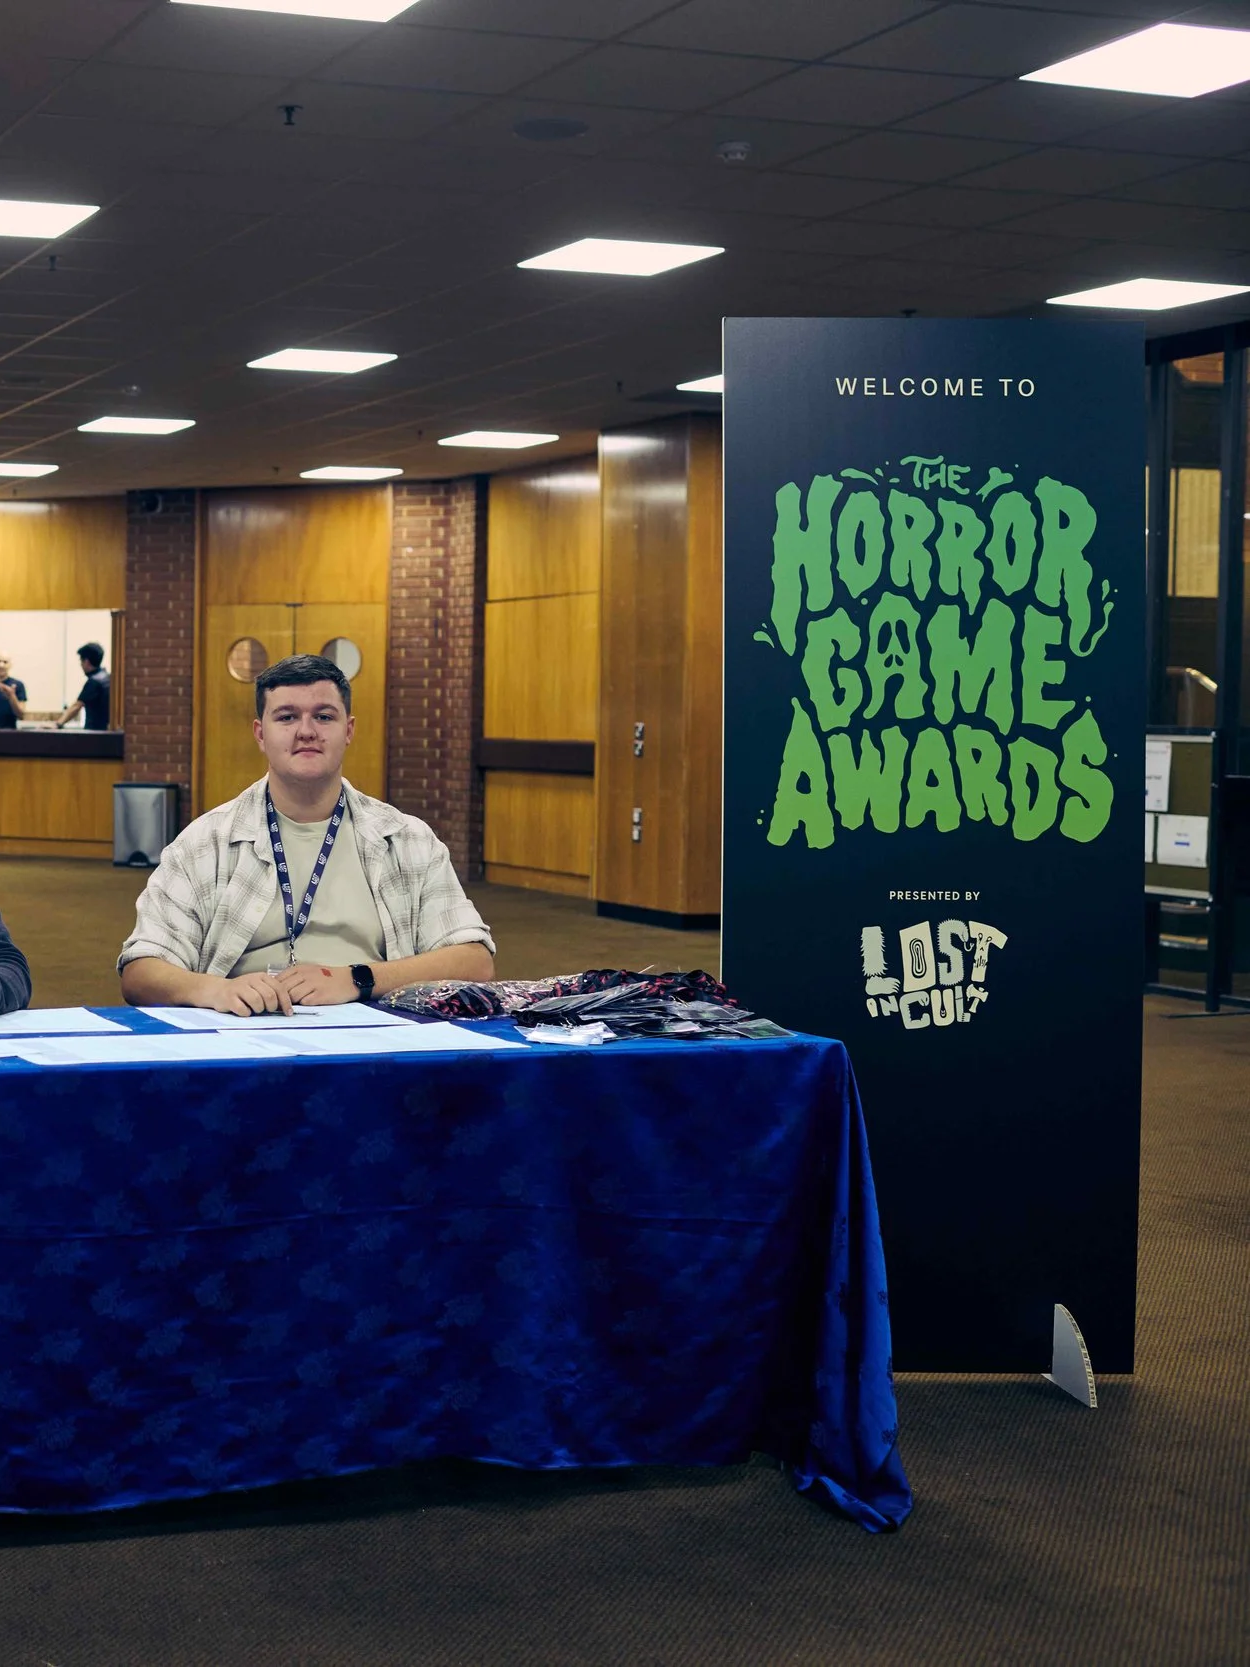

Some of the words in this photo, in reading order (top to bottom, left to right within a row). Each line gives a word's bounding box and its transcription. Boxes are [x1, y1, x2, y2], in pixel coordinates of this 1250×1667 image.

[835, 377, 984, 397] WELCOME
[998, 378, 1036, 397] TO
[900, 455, 971, 495] THE
[770, 474, 1100, 657] HORROR
[801, 592, 1076, 736] GAME
[766, 697, 1114, 849] AWARDS
[889, 891, 960, 901] PRESENTED
[965, 891, 980, 901] BY
[860, 918, 1008, 996] LOST
[866, 994, 900, 1018] IN
[899, 983, 989, 1030] CULT
